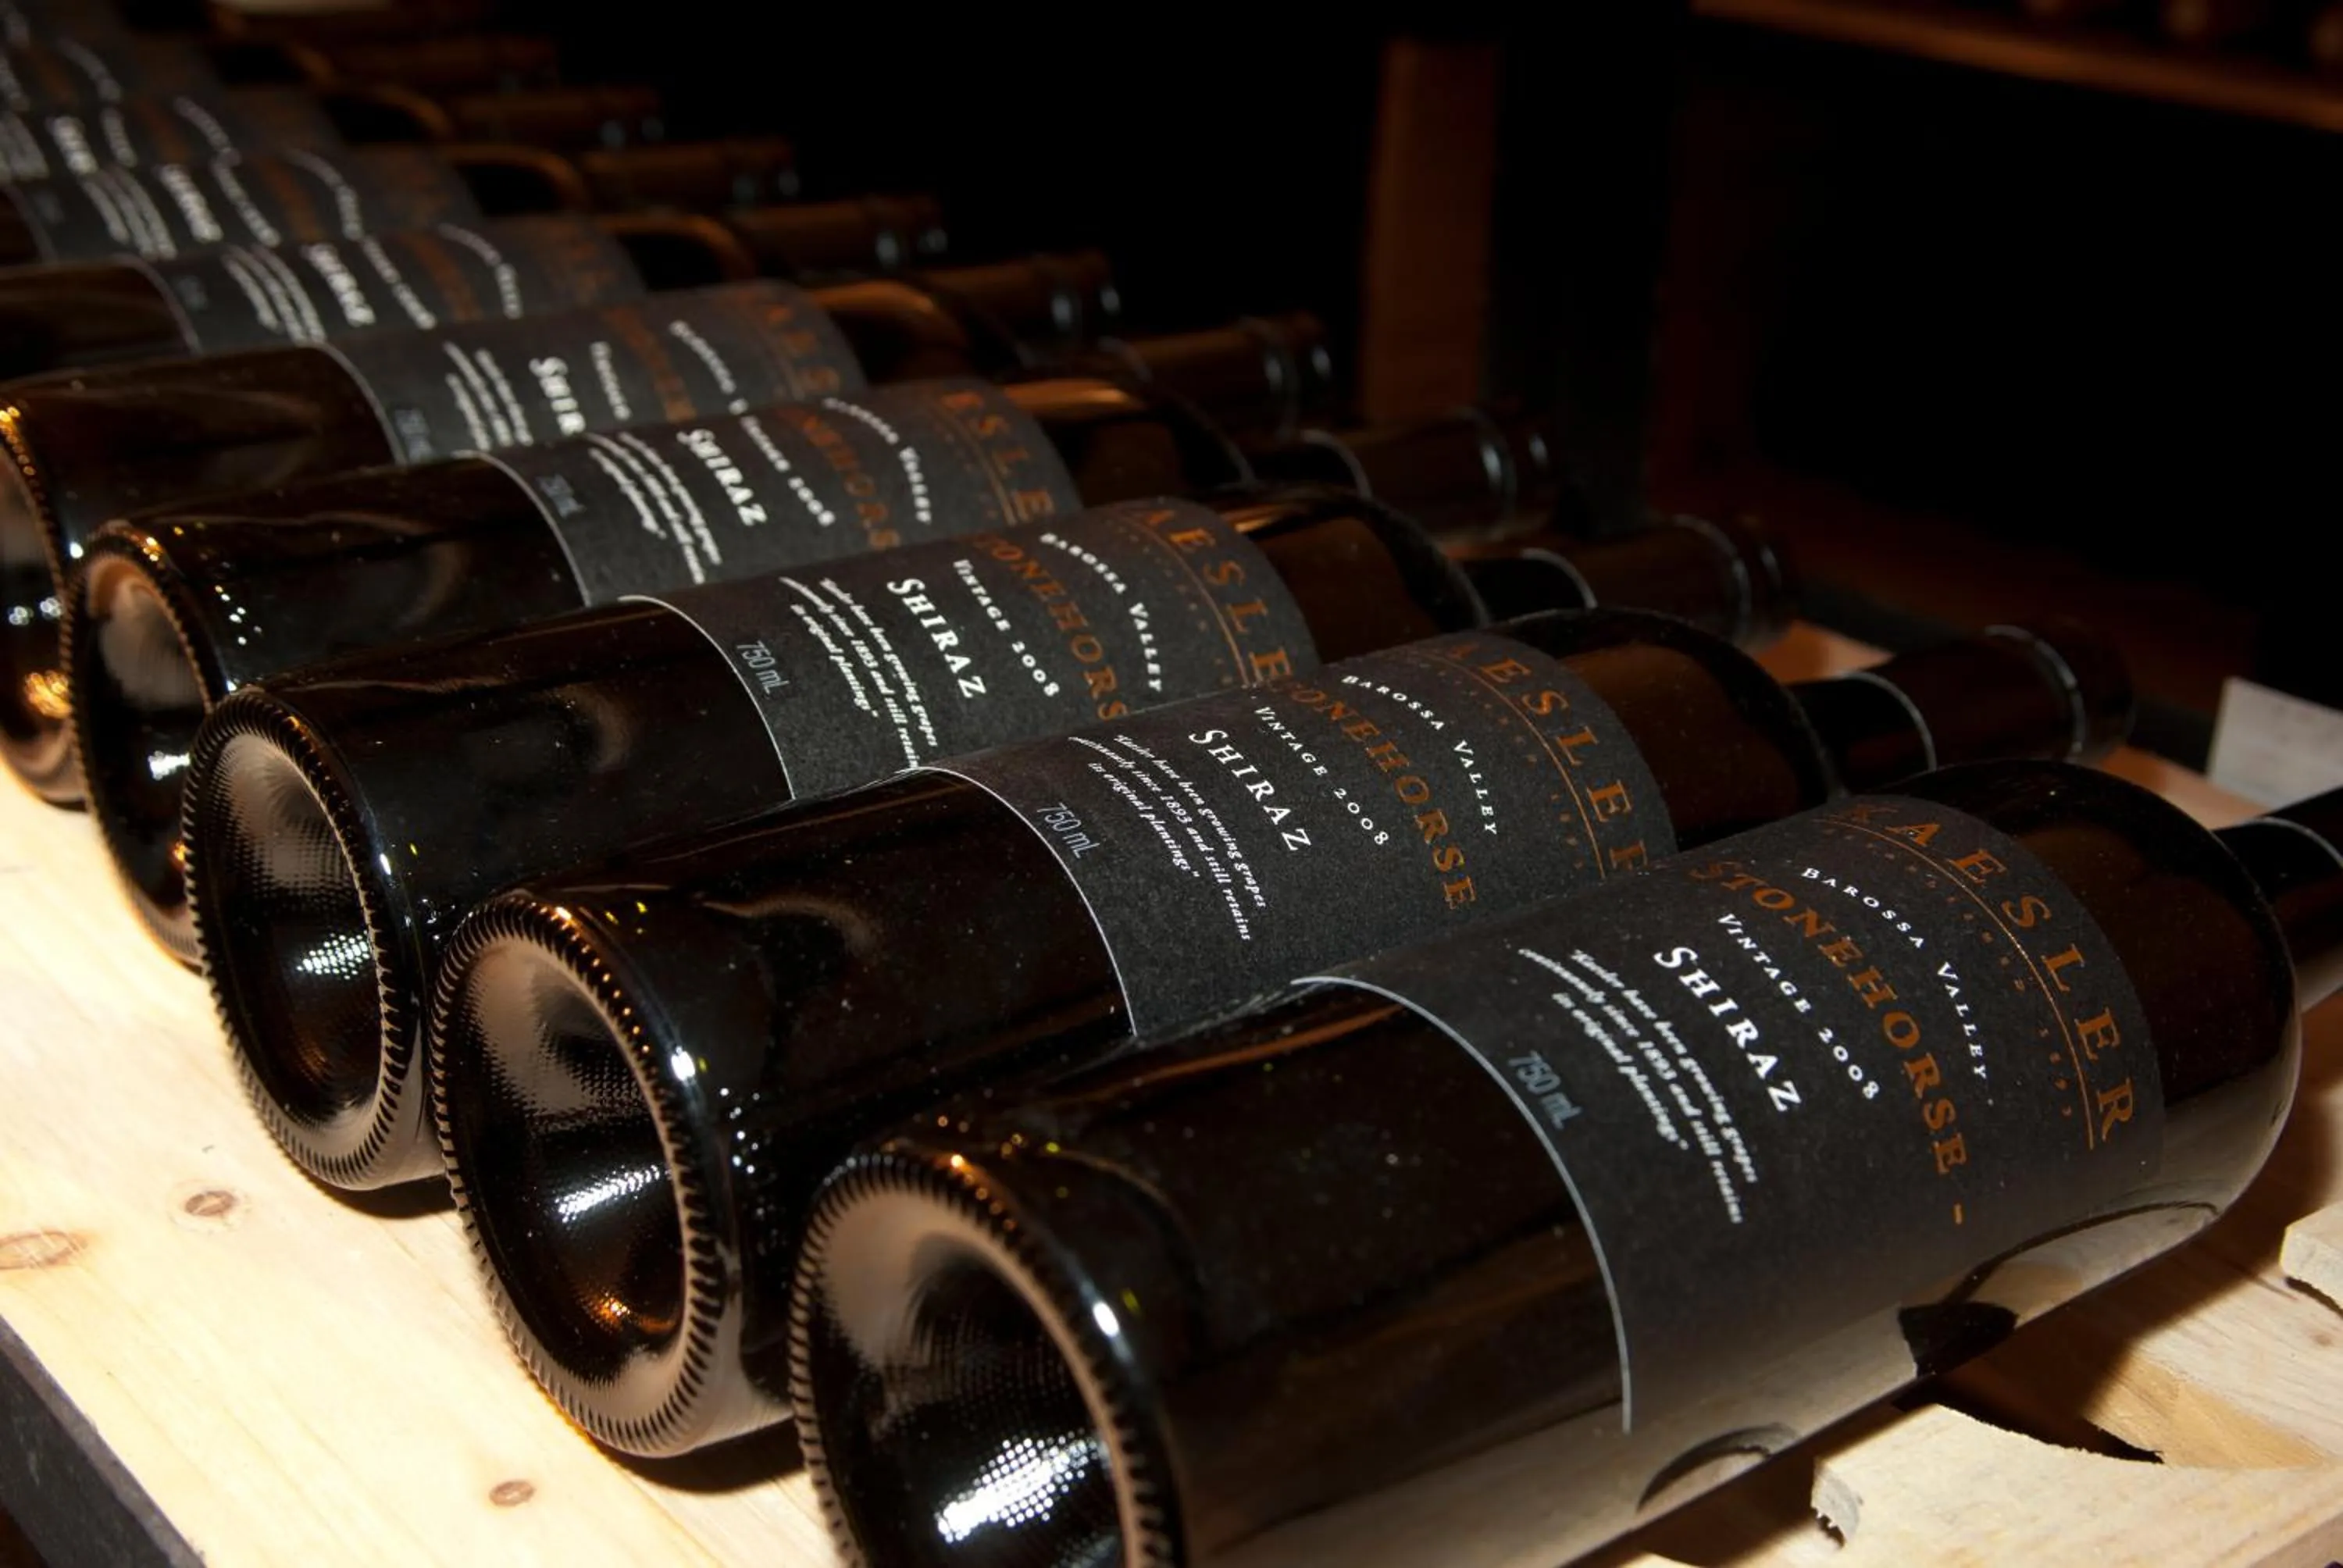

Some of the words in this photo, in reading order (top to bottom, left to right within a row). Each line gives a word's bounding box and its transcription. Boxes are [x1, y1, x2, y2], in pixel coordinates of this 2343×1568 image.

[736, 640, 777, 669] 750
[887, 578, 986, 698] SHIRAZ
[953, 559, 1011, 632] VINTAGE
[1012, 640, 1060, 697] 2008
[1129, 602, 1163, 693] VALLEY
[1104, 773, 1153, 811] original
[1189, 729, 1312, 851] SHIRAZ
[1254, 706, 1328, 777] VINTAGE
[1334, 788, 1389, 846] 2008
[1341, 675, 1445, 731] BAROSSA
[1453, 739, 1498, 836] VALLEY
[1037, 802, 1082, 832] 750
[1062, 831, 1100, 859] mL
[1160, 795, 1192, 824] 1893
[1186, 826, 1214, 852] and
[1205, 856, 1232, 884] still
[1223, 889, 1251, 941] retains
[1178, 781, 1205, 806] been
[1197, 807, 1243, 860] growing
[1234, 862, 1267, 908] grapes
[1653, 946, 1802, 1113] SHIRAZ
[1689, 861, 1969, 1175] STONEHORSE
[1718, 914, 1812, 1014] VINTAGE
[1817, 1028, 1880, 1100] 2008
[1801, 868, 1924, 950] BAROSSA
[1937, 961, 1987, 1080] VALLEY
[1507, 1051, 1560, 1093] 750
[1637, 1041, 1678, 1081] 1893
